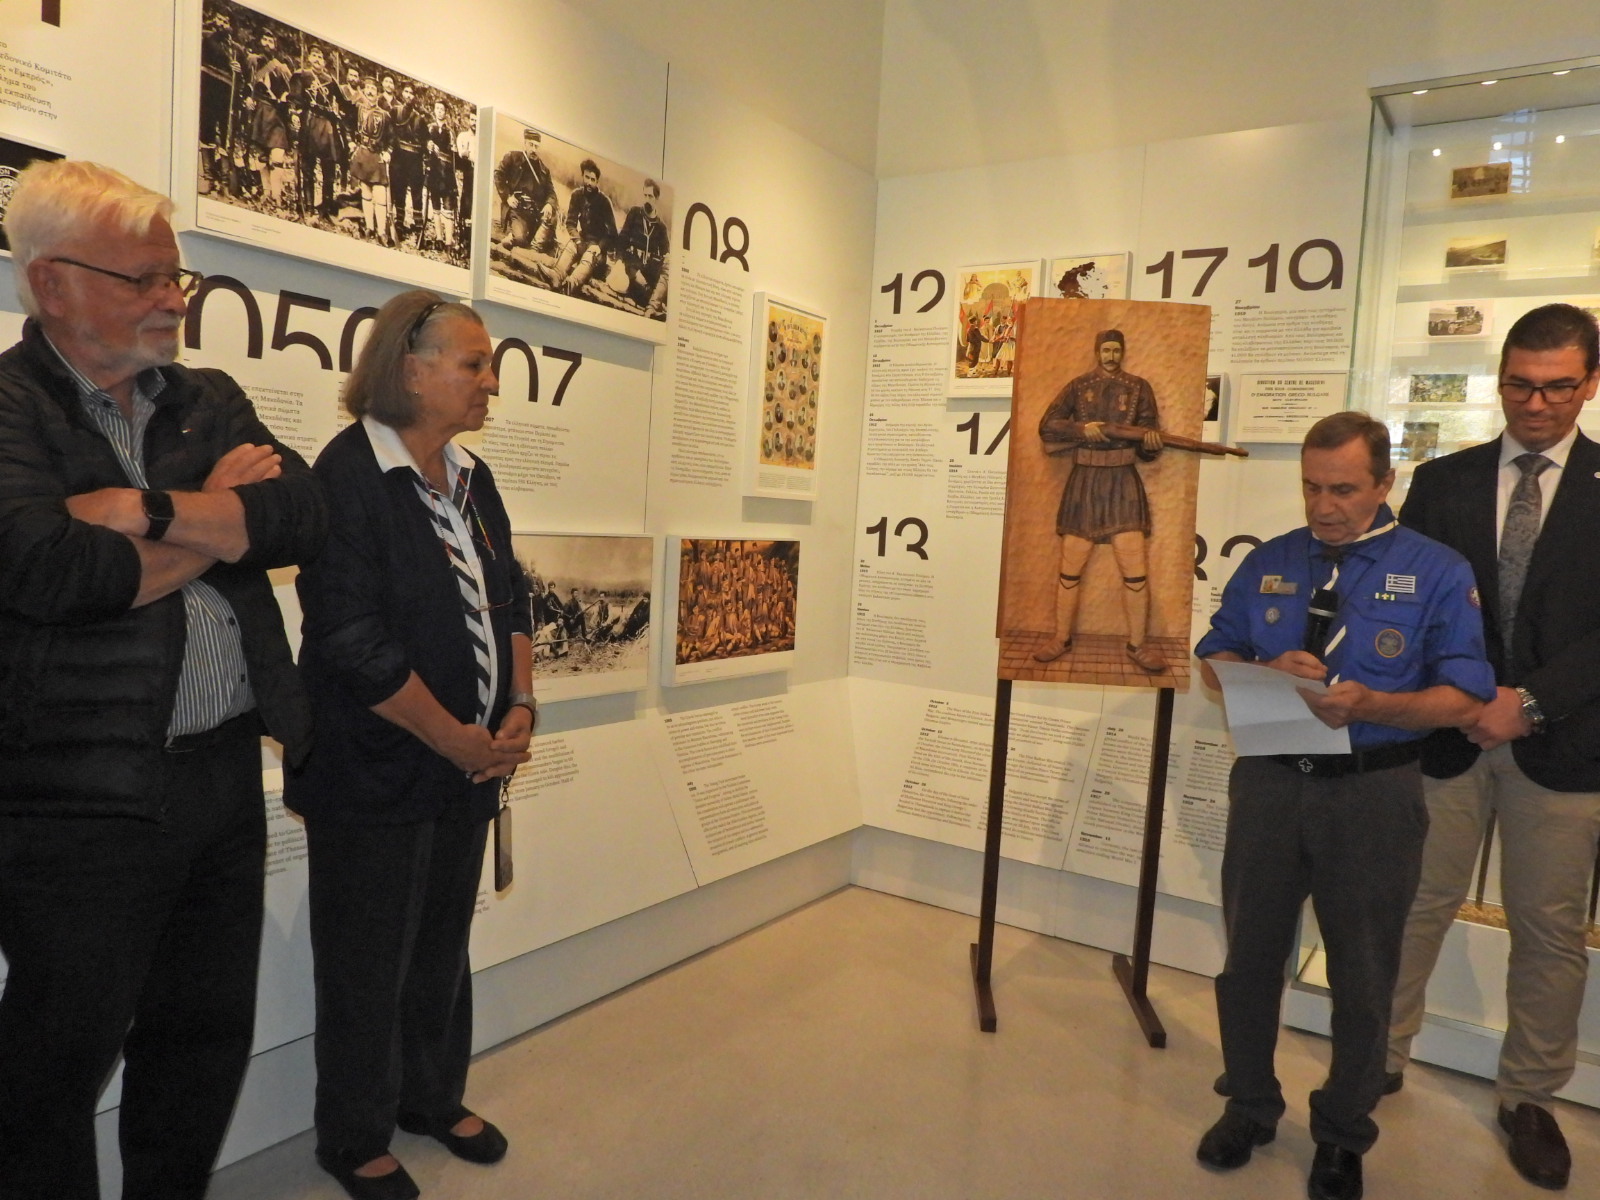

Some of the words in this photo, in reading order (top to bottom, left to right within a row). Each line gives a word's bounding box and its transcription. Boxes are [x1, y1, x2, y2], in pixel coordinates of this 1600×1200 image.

[35, 63, 72, 80] Κομιτάτο
[682, 202, 750, 272] 08
[881, 269, 946, 314] 12
[1146, 247, 1228, 298] 17
[488, 337, 582, 406] 07
[866, 516, 929, 560] 13
